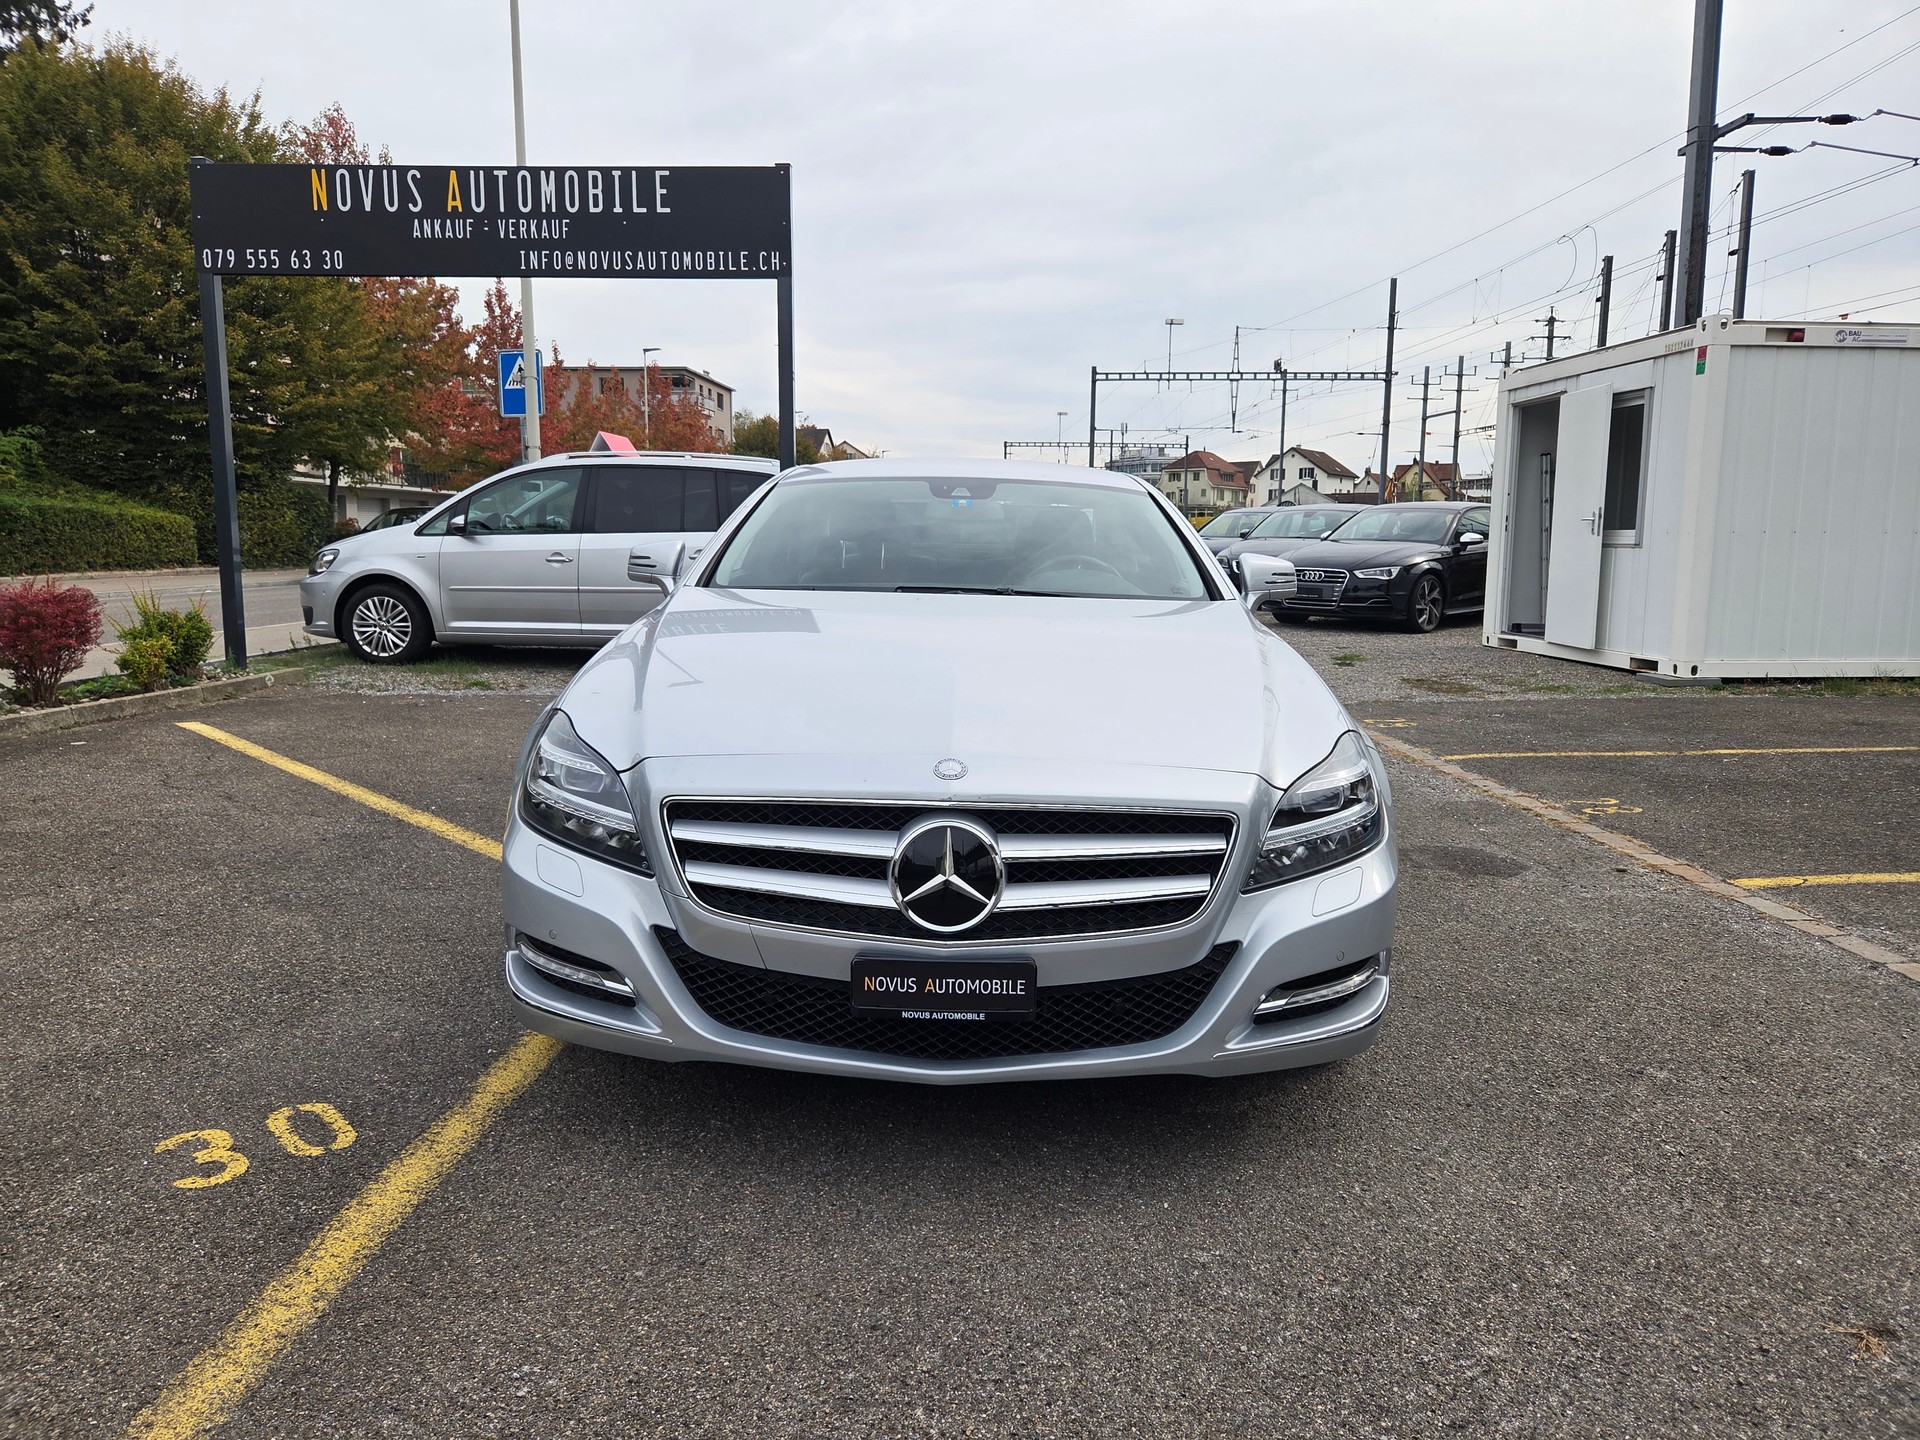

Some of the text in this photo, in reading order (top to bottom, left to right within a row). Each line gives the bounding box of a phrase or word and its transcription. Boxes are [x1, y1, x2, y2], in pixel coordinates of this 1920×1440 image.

[311, 168, 671, 213] NOVUS AUTOMOBILE
[413, 218, 474, 239] ANKAUF
[498, 218, 570, 239] VERKAUF
[202, 248, 343, 270] 079 555 63 30
[519, 250, 780, 272] INFO@NOVUSAUTOMOBILE.CH
[864, 976, 1026, 995] NOVUS AUTOMOBILE
[901, 1011, 986, 1021] NOVUS AUTOMOBILE
[153, 1102, 358, 1189] 30
